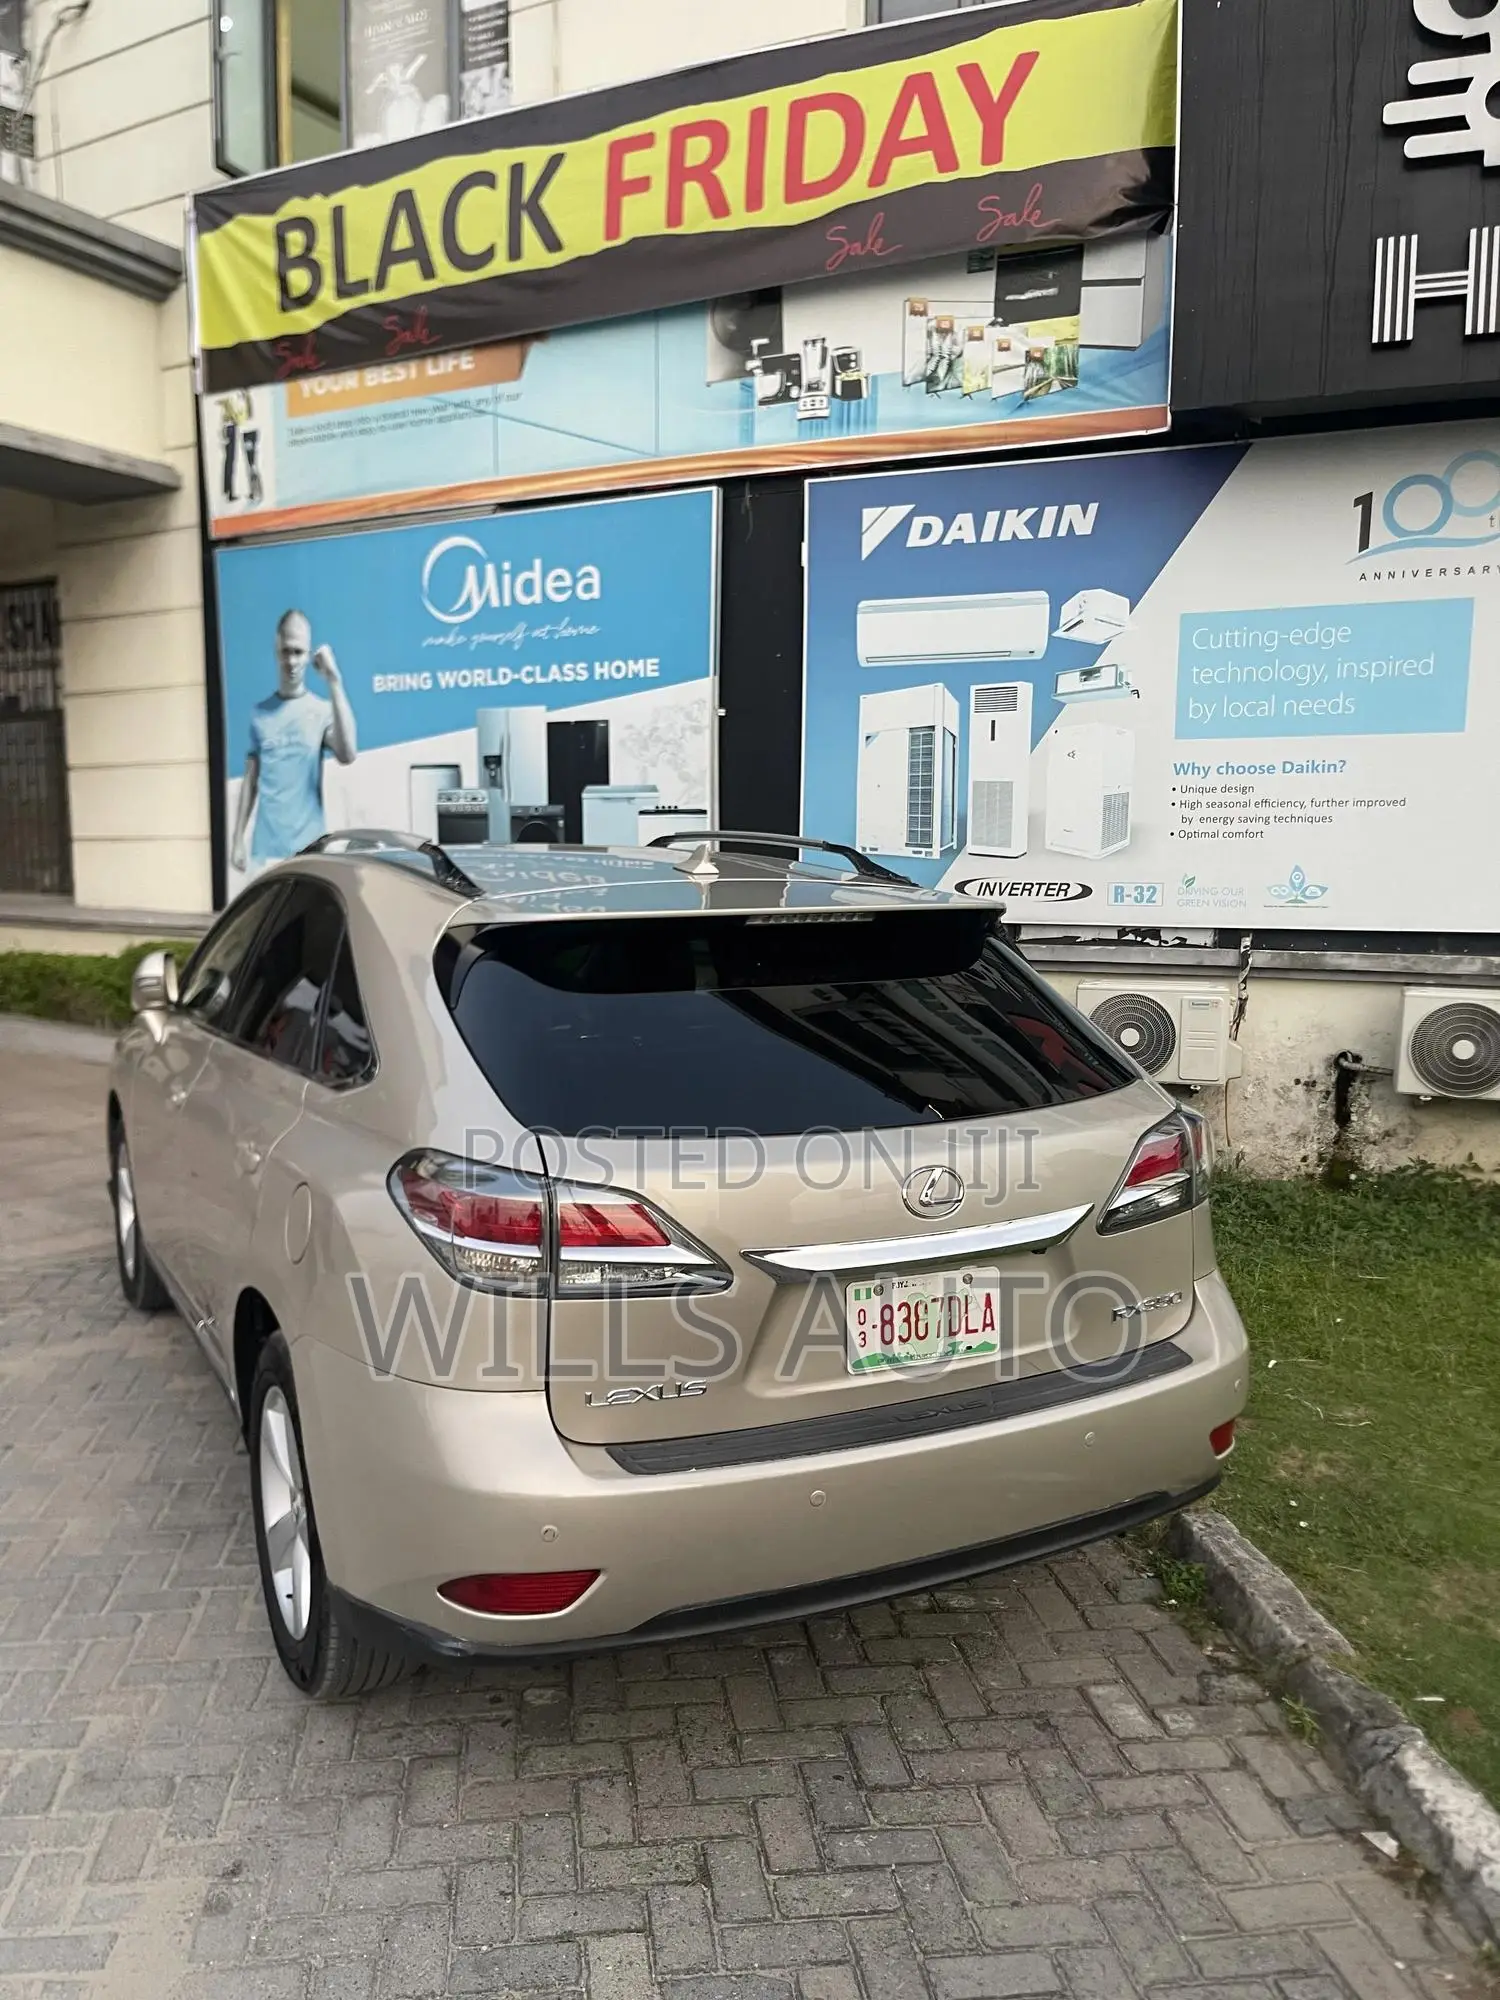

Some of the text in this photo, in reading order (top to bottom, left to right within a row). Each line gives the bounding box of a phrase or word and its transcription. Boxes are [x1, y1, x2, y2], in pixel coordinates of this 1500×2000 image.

[275, 50, 1040, 313] BLACK FRIDAY
[976, 183, 1061, 242] Sale
[826, 212, 901, 271] Sale
[382, 304, 443, 355] Sale
[299, 351, 476, 398] YOUR BEST LIFE
[905, 502, 1099, 548] DAIKIN
[450, 556, 601, 612] Midea
[1192, 621, 1352, 652] Cutting-edge
[372, 657, 660, 694] BRING WORLD-CLASS HOME
[1191, 652, 1435, 686] technology, inspired
[1188, 691, 1356, 724] by local needs
[1173, 759, 1346, 779] Why choose Daikin?
[1179, 797, 1406, 811] High seasonal efficiency, further improved
[1180, 783, 1255, 796] Unique design
[1178, 828, 1264, 840] Optimal comfort
[1181, 813, 1333, 826] by energy saving techniques
[977, 881, 1071, 898] INVERTER
[1113, 884, 1157, 905] R-32
[1177, 886, 1245, 897] DRIVING OUR
[1177, 898, 1247, 908] GREEN VISION
[584, 1380, 707, 1408] LEXUS
